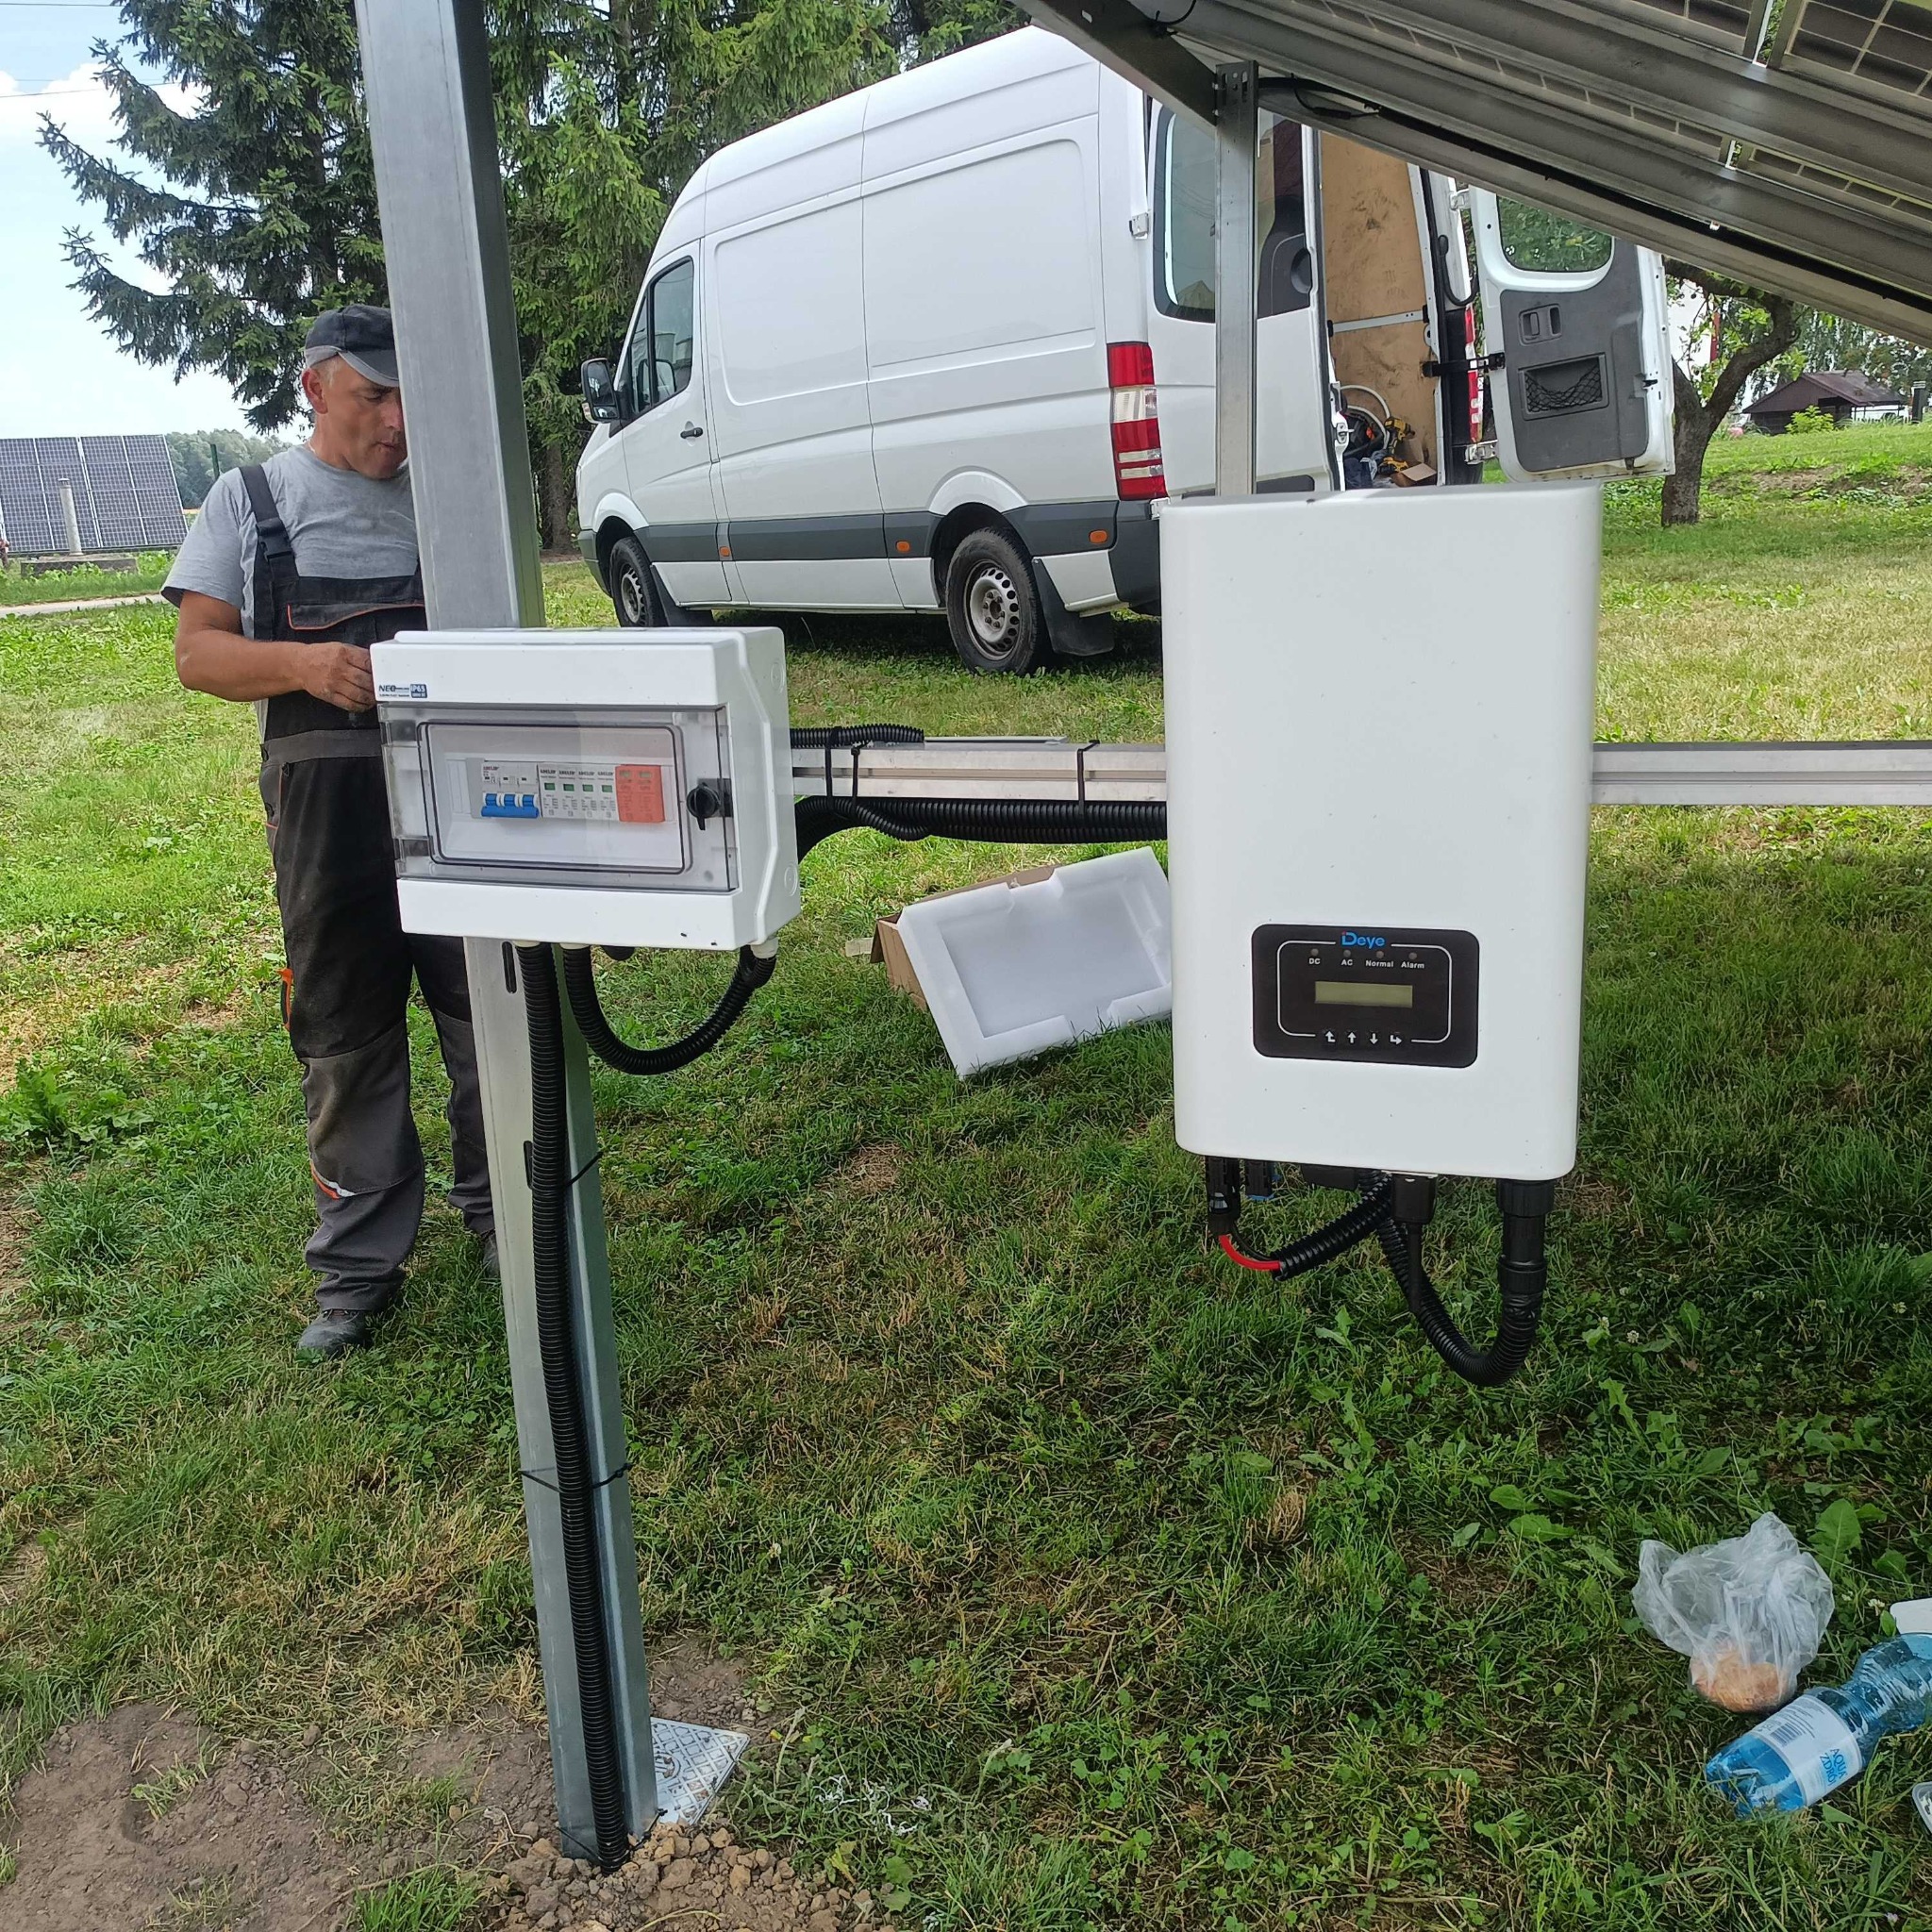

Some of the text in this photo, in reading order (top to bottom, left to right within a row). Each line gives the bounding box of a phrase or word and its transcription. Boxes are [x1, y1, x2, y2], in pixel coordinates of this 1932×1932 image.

[1341, 930, 1385, 949] Deye
[1365, 959, 1394, 968] Normal
[1401, 960, 1425, 969] Alarm
[1830, 1748, 1847, 1779] AQUA
